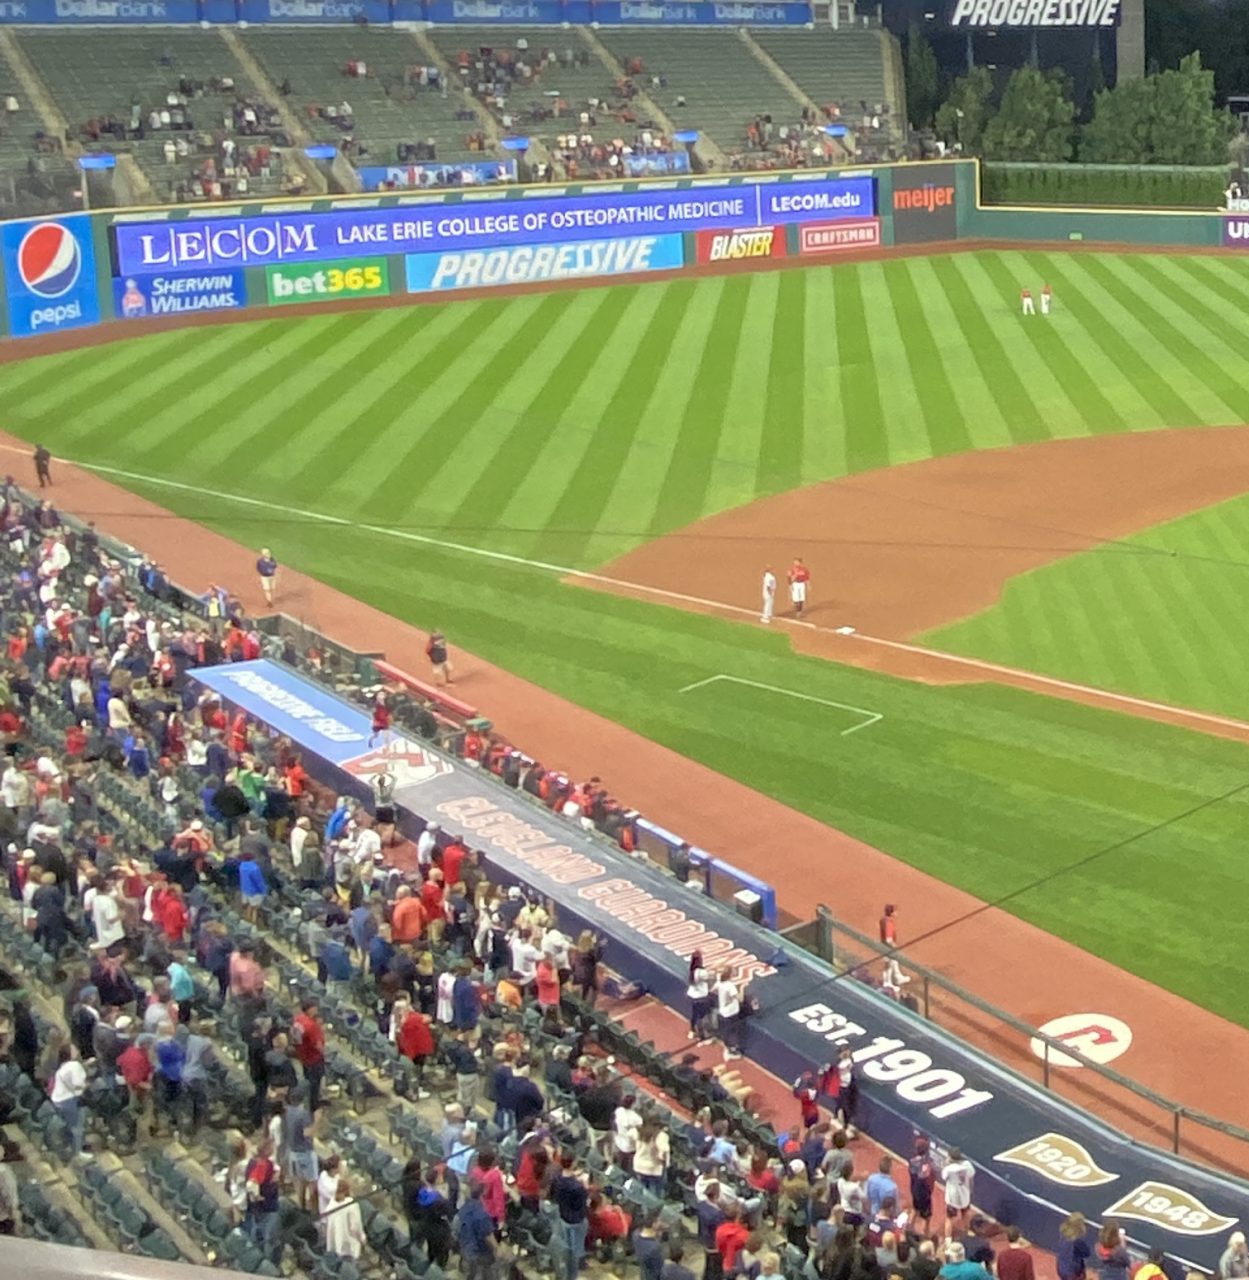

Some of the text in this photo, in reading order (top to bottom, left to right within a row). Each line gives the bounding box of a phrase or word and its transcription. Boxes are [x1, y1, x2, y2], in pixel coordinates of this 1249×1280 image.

[453, 0, 539, 18] DollarBank
[619, 1, 697, 19] DollarBank
[714, 0, 785, 20] DollarBank
[771, 191, 860, 213] LECOM.edu
[893, 183, 954, 211] meijer
[336, 199, 744, 244] LAKE ERIE COLLEGE OF OSTEOPATHIC MEDICINE
[807, 229, 875, 246] CRAFTSMAN
[141, 222, 318, 265] LECOM
[709, 229, 774, 261] BLASTER
[432, 239, 657, 289] PROGRESSIVE
[152, 274, 233, 296] SHERWIN
[272, 265, 382, 298] bet365
[30, 299, 82, 329] pepsi
[436, 796, 778, 987] CLEVELAND GUARDIANS
[788, 1002, 994, 1119] EST. 1901
[1026, 1138, 1091, 1182] 1920
[1132, 1187, 1210, 1231] 1948
